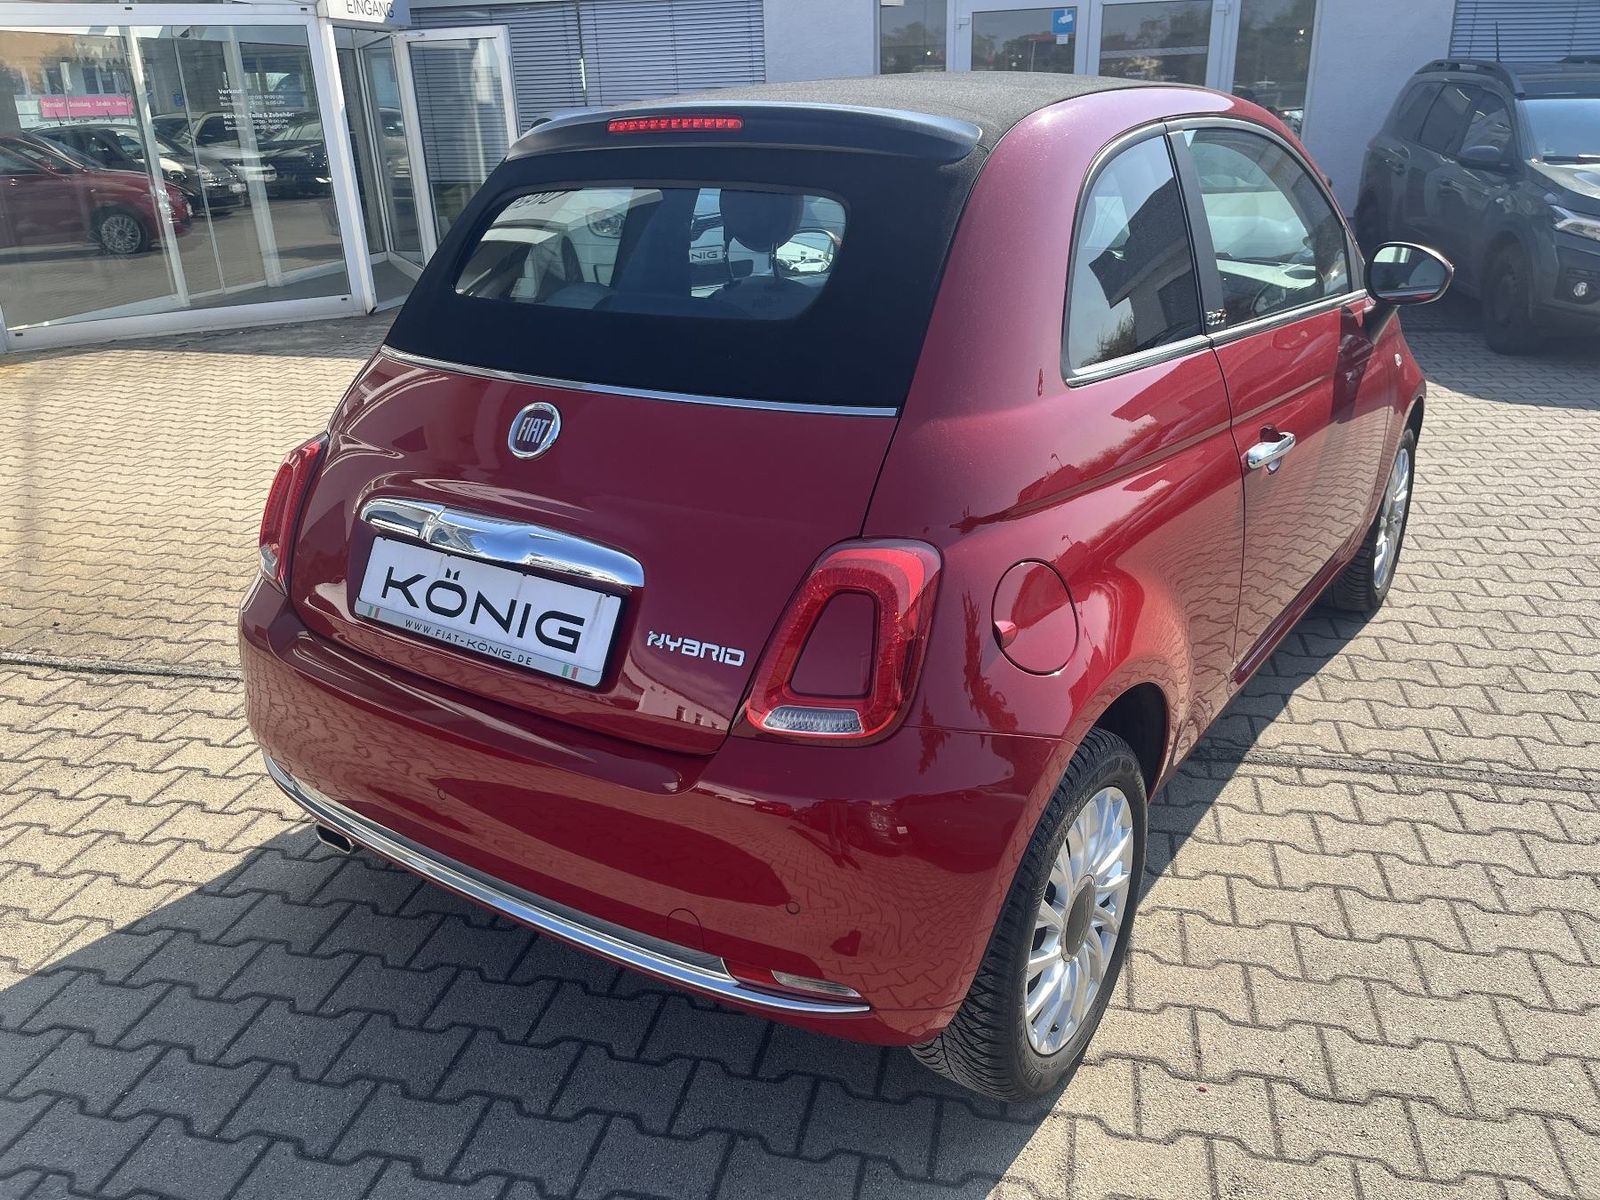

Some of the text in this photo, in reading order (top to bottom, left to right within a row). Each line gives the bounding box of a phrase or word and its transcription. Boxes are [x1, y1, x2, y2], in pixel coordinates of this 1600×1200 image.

[346, 0, 395, 18] EINGANG
[516, 416, 551, 444] FIAT
[380, 566, 586, 654] KÖNIG
[404, 619, 533, 666] WWW.FIAT-KÖNIG.DE
[646, 630, 745, 667] HYBRID
